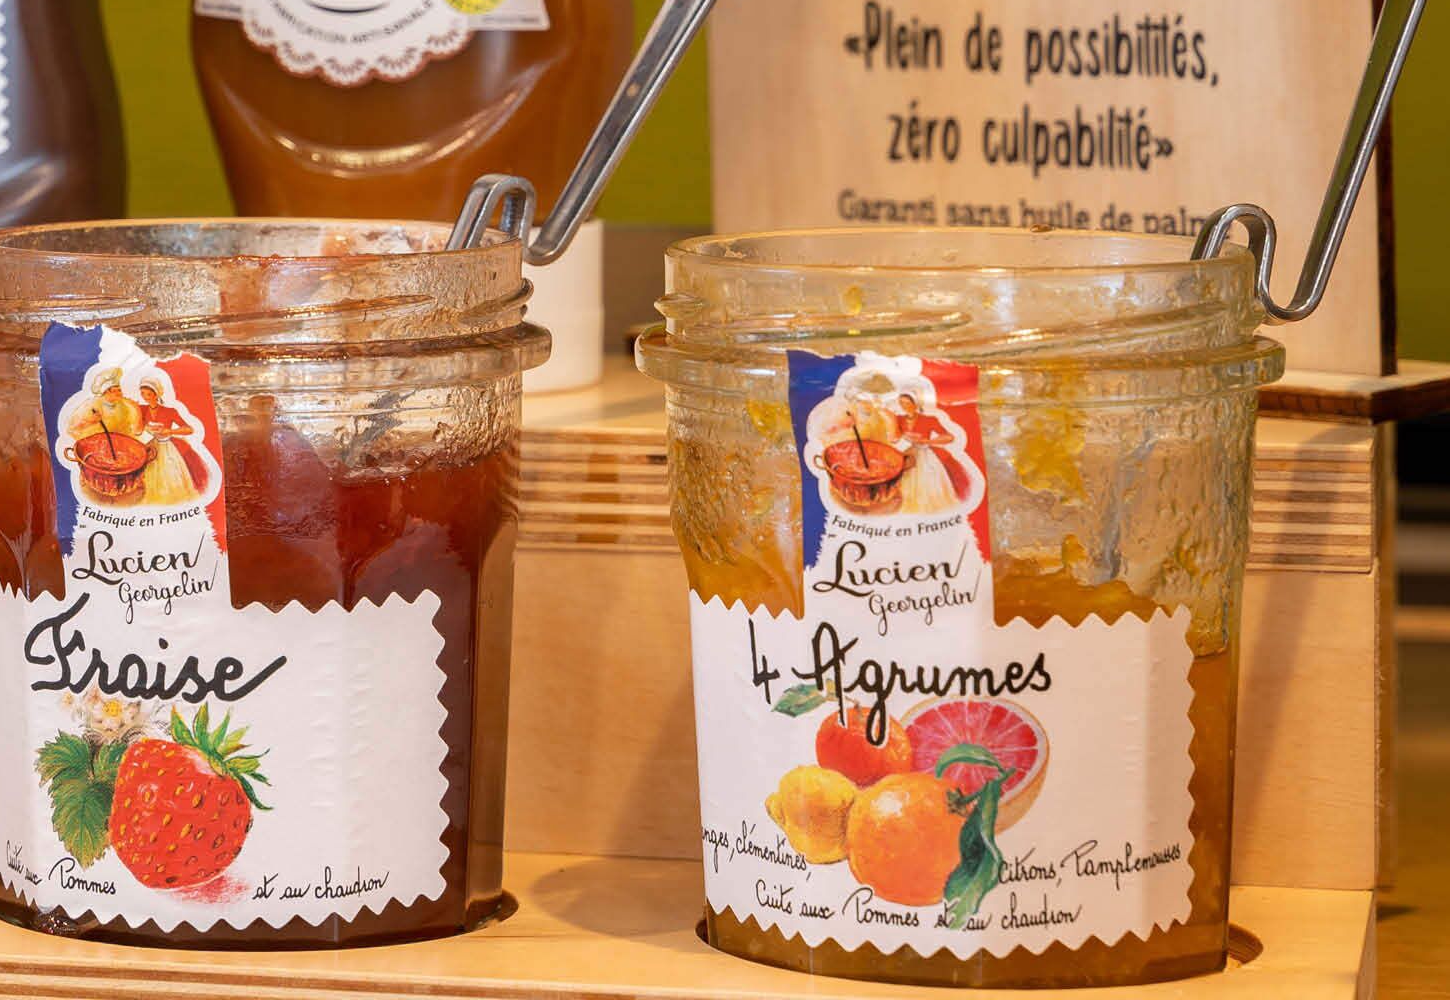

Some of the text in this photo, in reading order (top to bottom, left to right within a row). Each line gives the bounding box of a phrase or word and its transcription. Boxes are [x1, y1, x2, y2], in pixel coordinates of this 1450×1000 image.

[965, 11, 1003, 74] de
[888, 100, 1175, 179] zéro culpabilité»
[837, 187, 938, 226] Garanti
[946, 200, 1011, 228] sans
[1100, 201, 1134, 232] de
[82, 504, 200, 528] Fabriqué en France
[831, 514, 963, 537] Fabriqué en France
[72, 529, 206, 584] Lucien
[812, 540, 968, 597] Lucien
[118, 560, 218, 624] Georgelin
[868, 566, 982, 637] Georgelin
[24, 592, 287, 703] Fraise
[747, 618, 1053, 747] 4 Agrumes
[48, 857, 117, 896] Pommes
[253, 872, 280, 901] et
[280, 880, 310, 901] au
[314, 866, 390, 900] chaudron
[736, 820, 812, 881] clémentines,
[998, 847, 1063, 889] Citrons,
[756, 879, 1082, 931] Cuits aux Pommes et au chaudron
